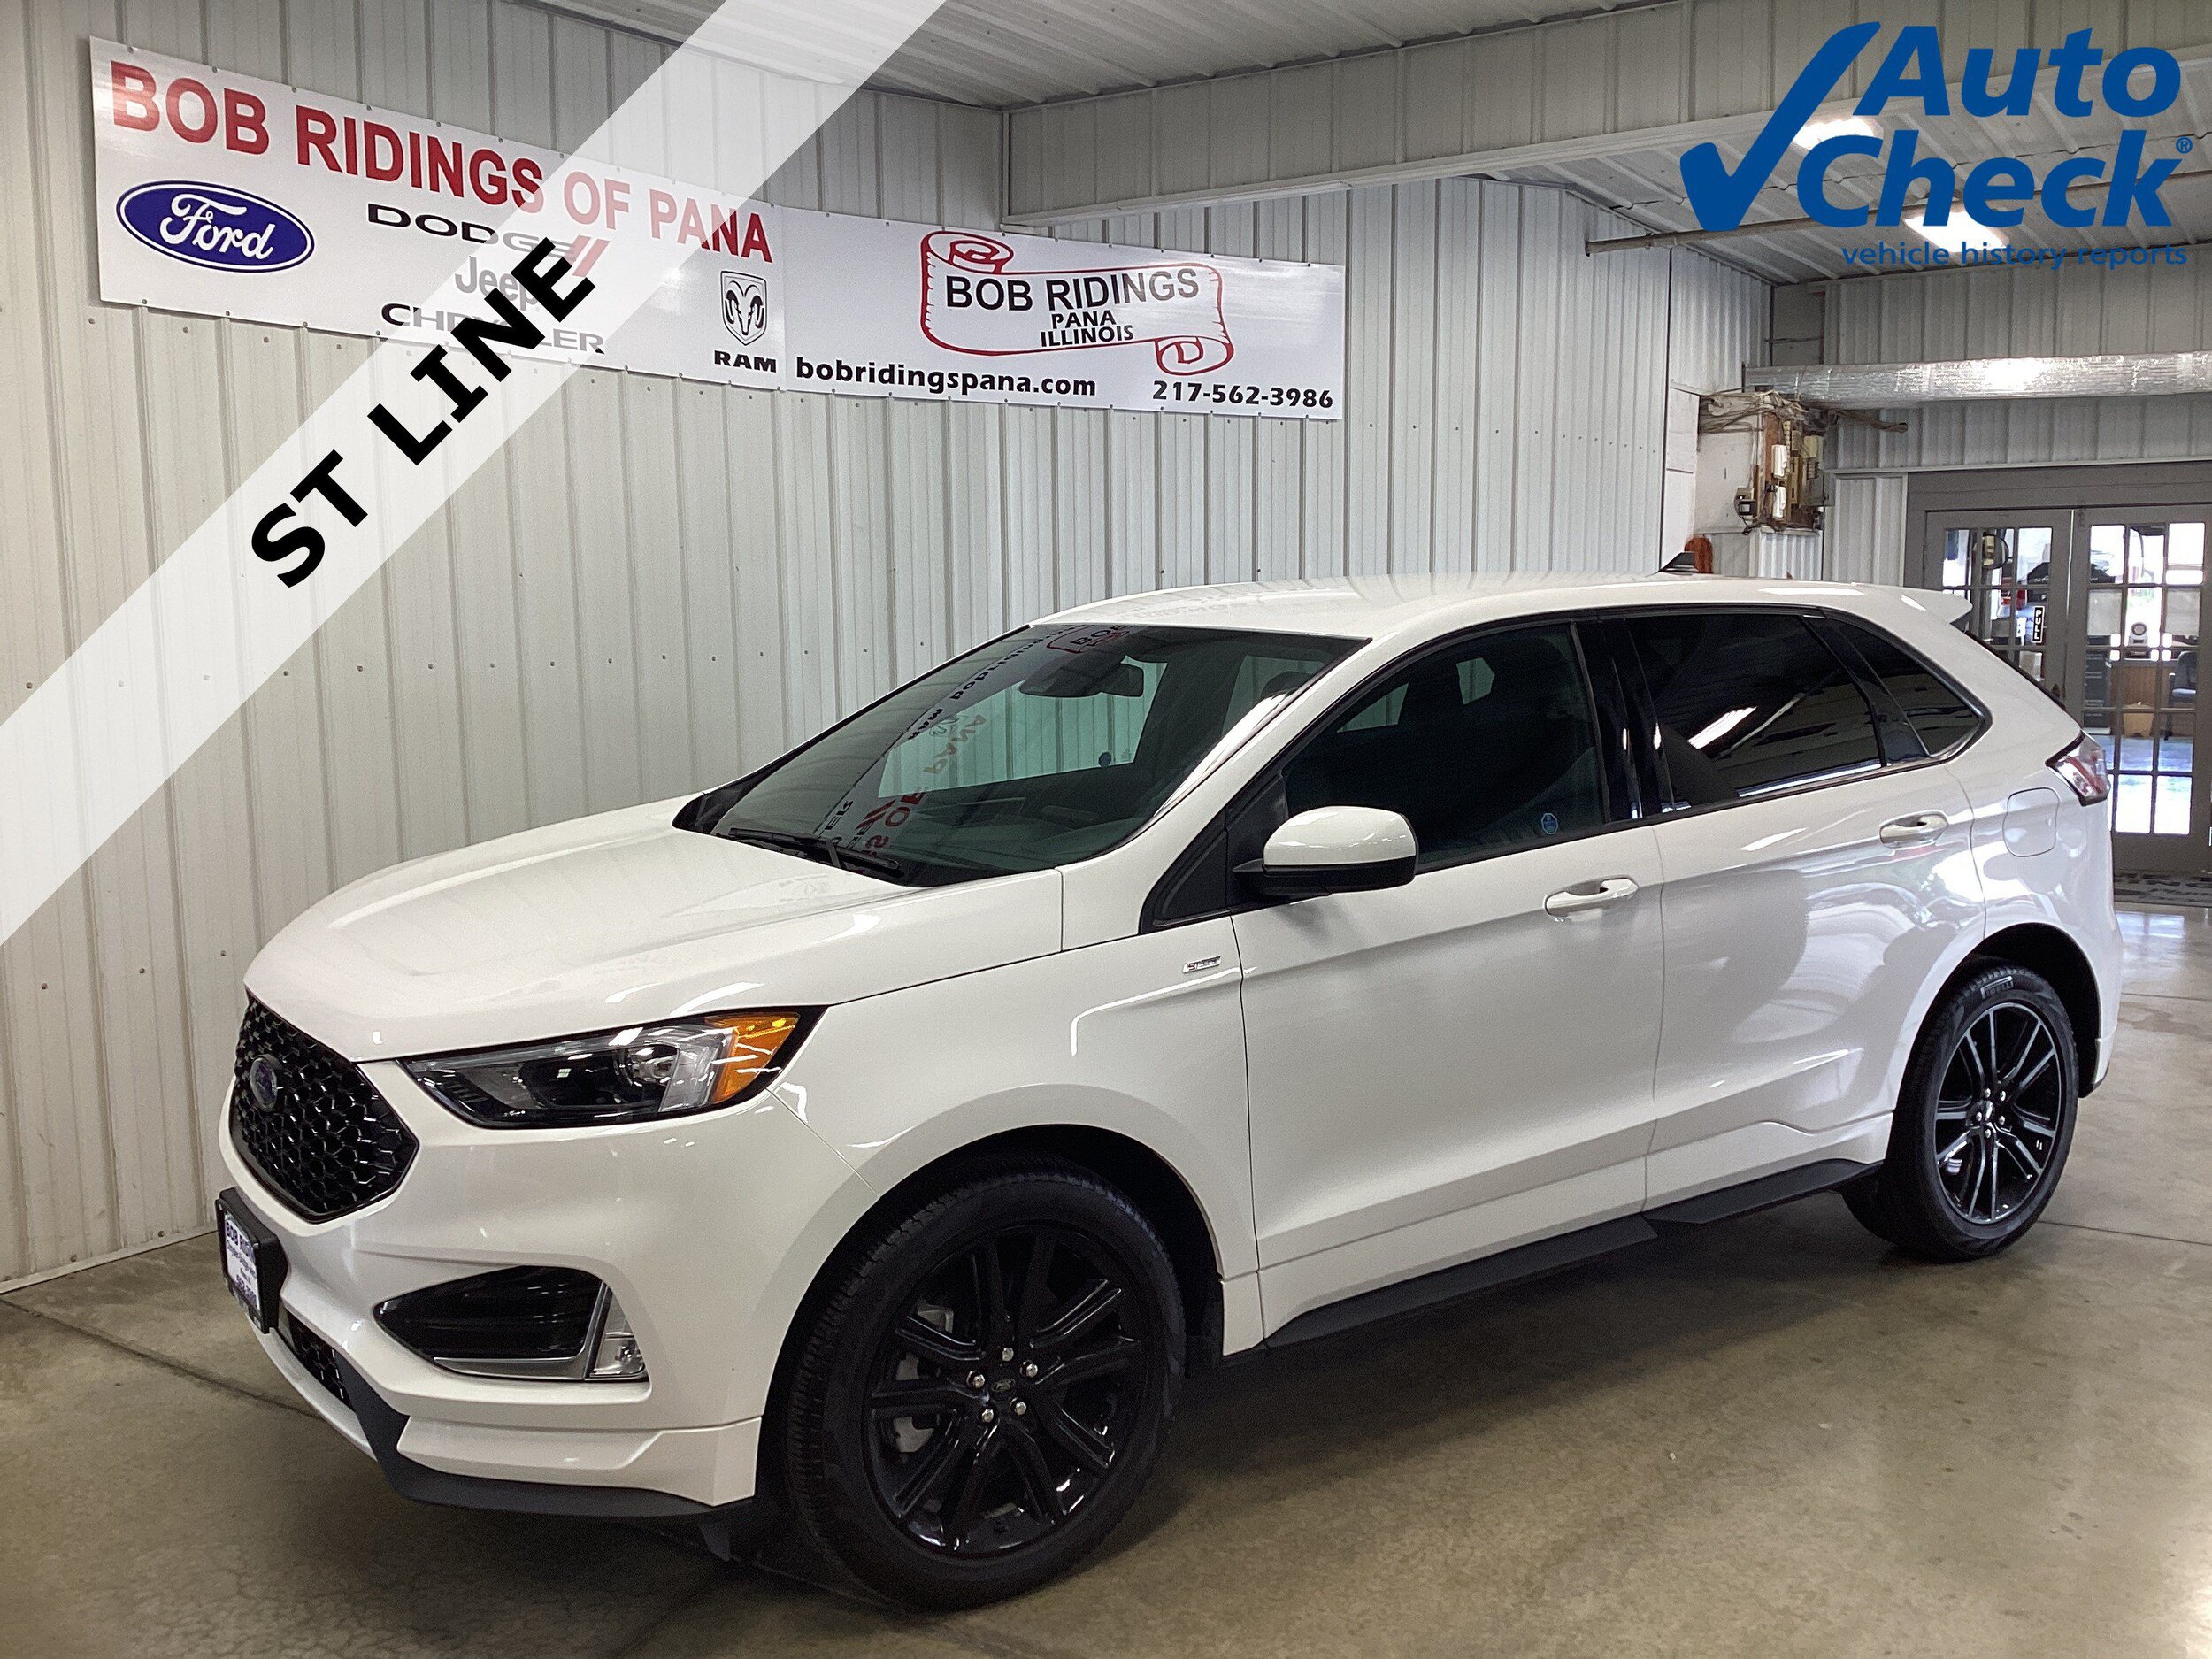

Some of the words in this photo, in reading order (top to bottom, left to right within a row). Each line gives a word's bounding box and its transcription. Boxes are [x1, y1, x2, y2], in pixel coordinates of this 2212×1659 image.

[110, 60, 271, 156] BOB
[295, 104, 545, 214] RIDINGS
[563, 171, 632, 231] OF
[649, 190, 774, 264] PANA
[159, 191, 276, 261] Ford
[367, 203, 577, 262] DODGE
[454, 256, 540, 311] Jeep
[946, 275, 1033, 311] BOB
[1046, 268, 1200, 311] RIDINGS
[1040, 324, 1134, 348] ILLINOIS
[1051, 310, 1117, 330] PANA
[714, 349, 777, 373] RAM
[795, 357, 1096, 397] bobridingspana.com
[1152, 380, 1334, 410] 217-562-3986
[2033, 609, 2042, 640] PULL
